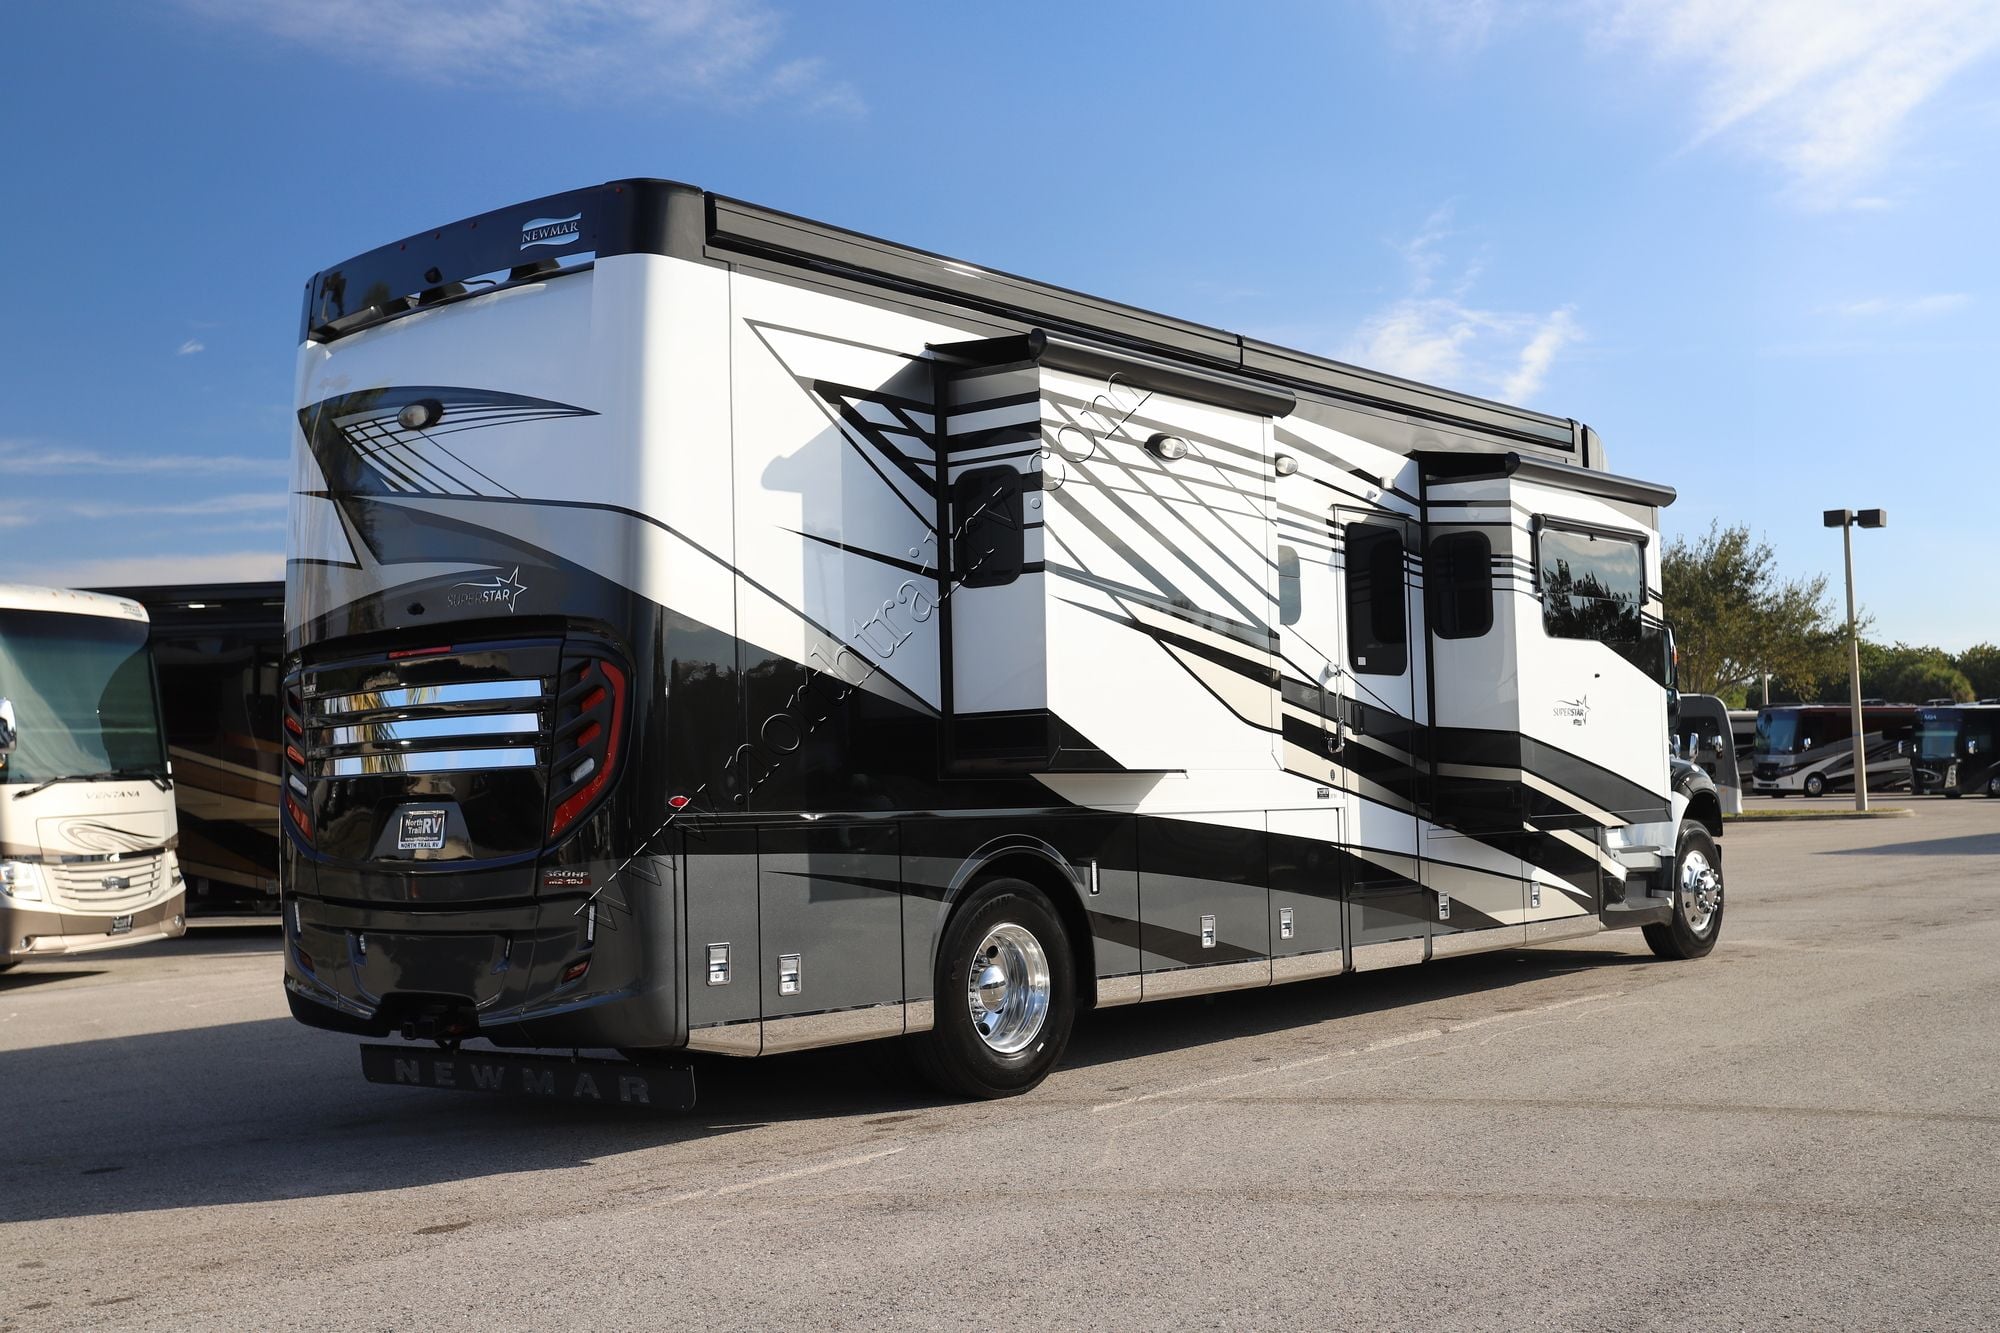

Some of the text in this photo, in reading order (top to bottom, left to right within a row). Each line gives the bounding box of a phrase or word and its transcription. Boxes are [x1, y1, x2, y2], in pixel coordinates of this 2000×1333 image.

[522, 221, 579, 243] NEWMAR
[423, 818, 441, 834] RV
[394, 1057, 650, 1104] NEWMAR
